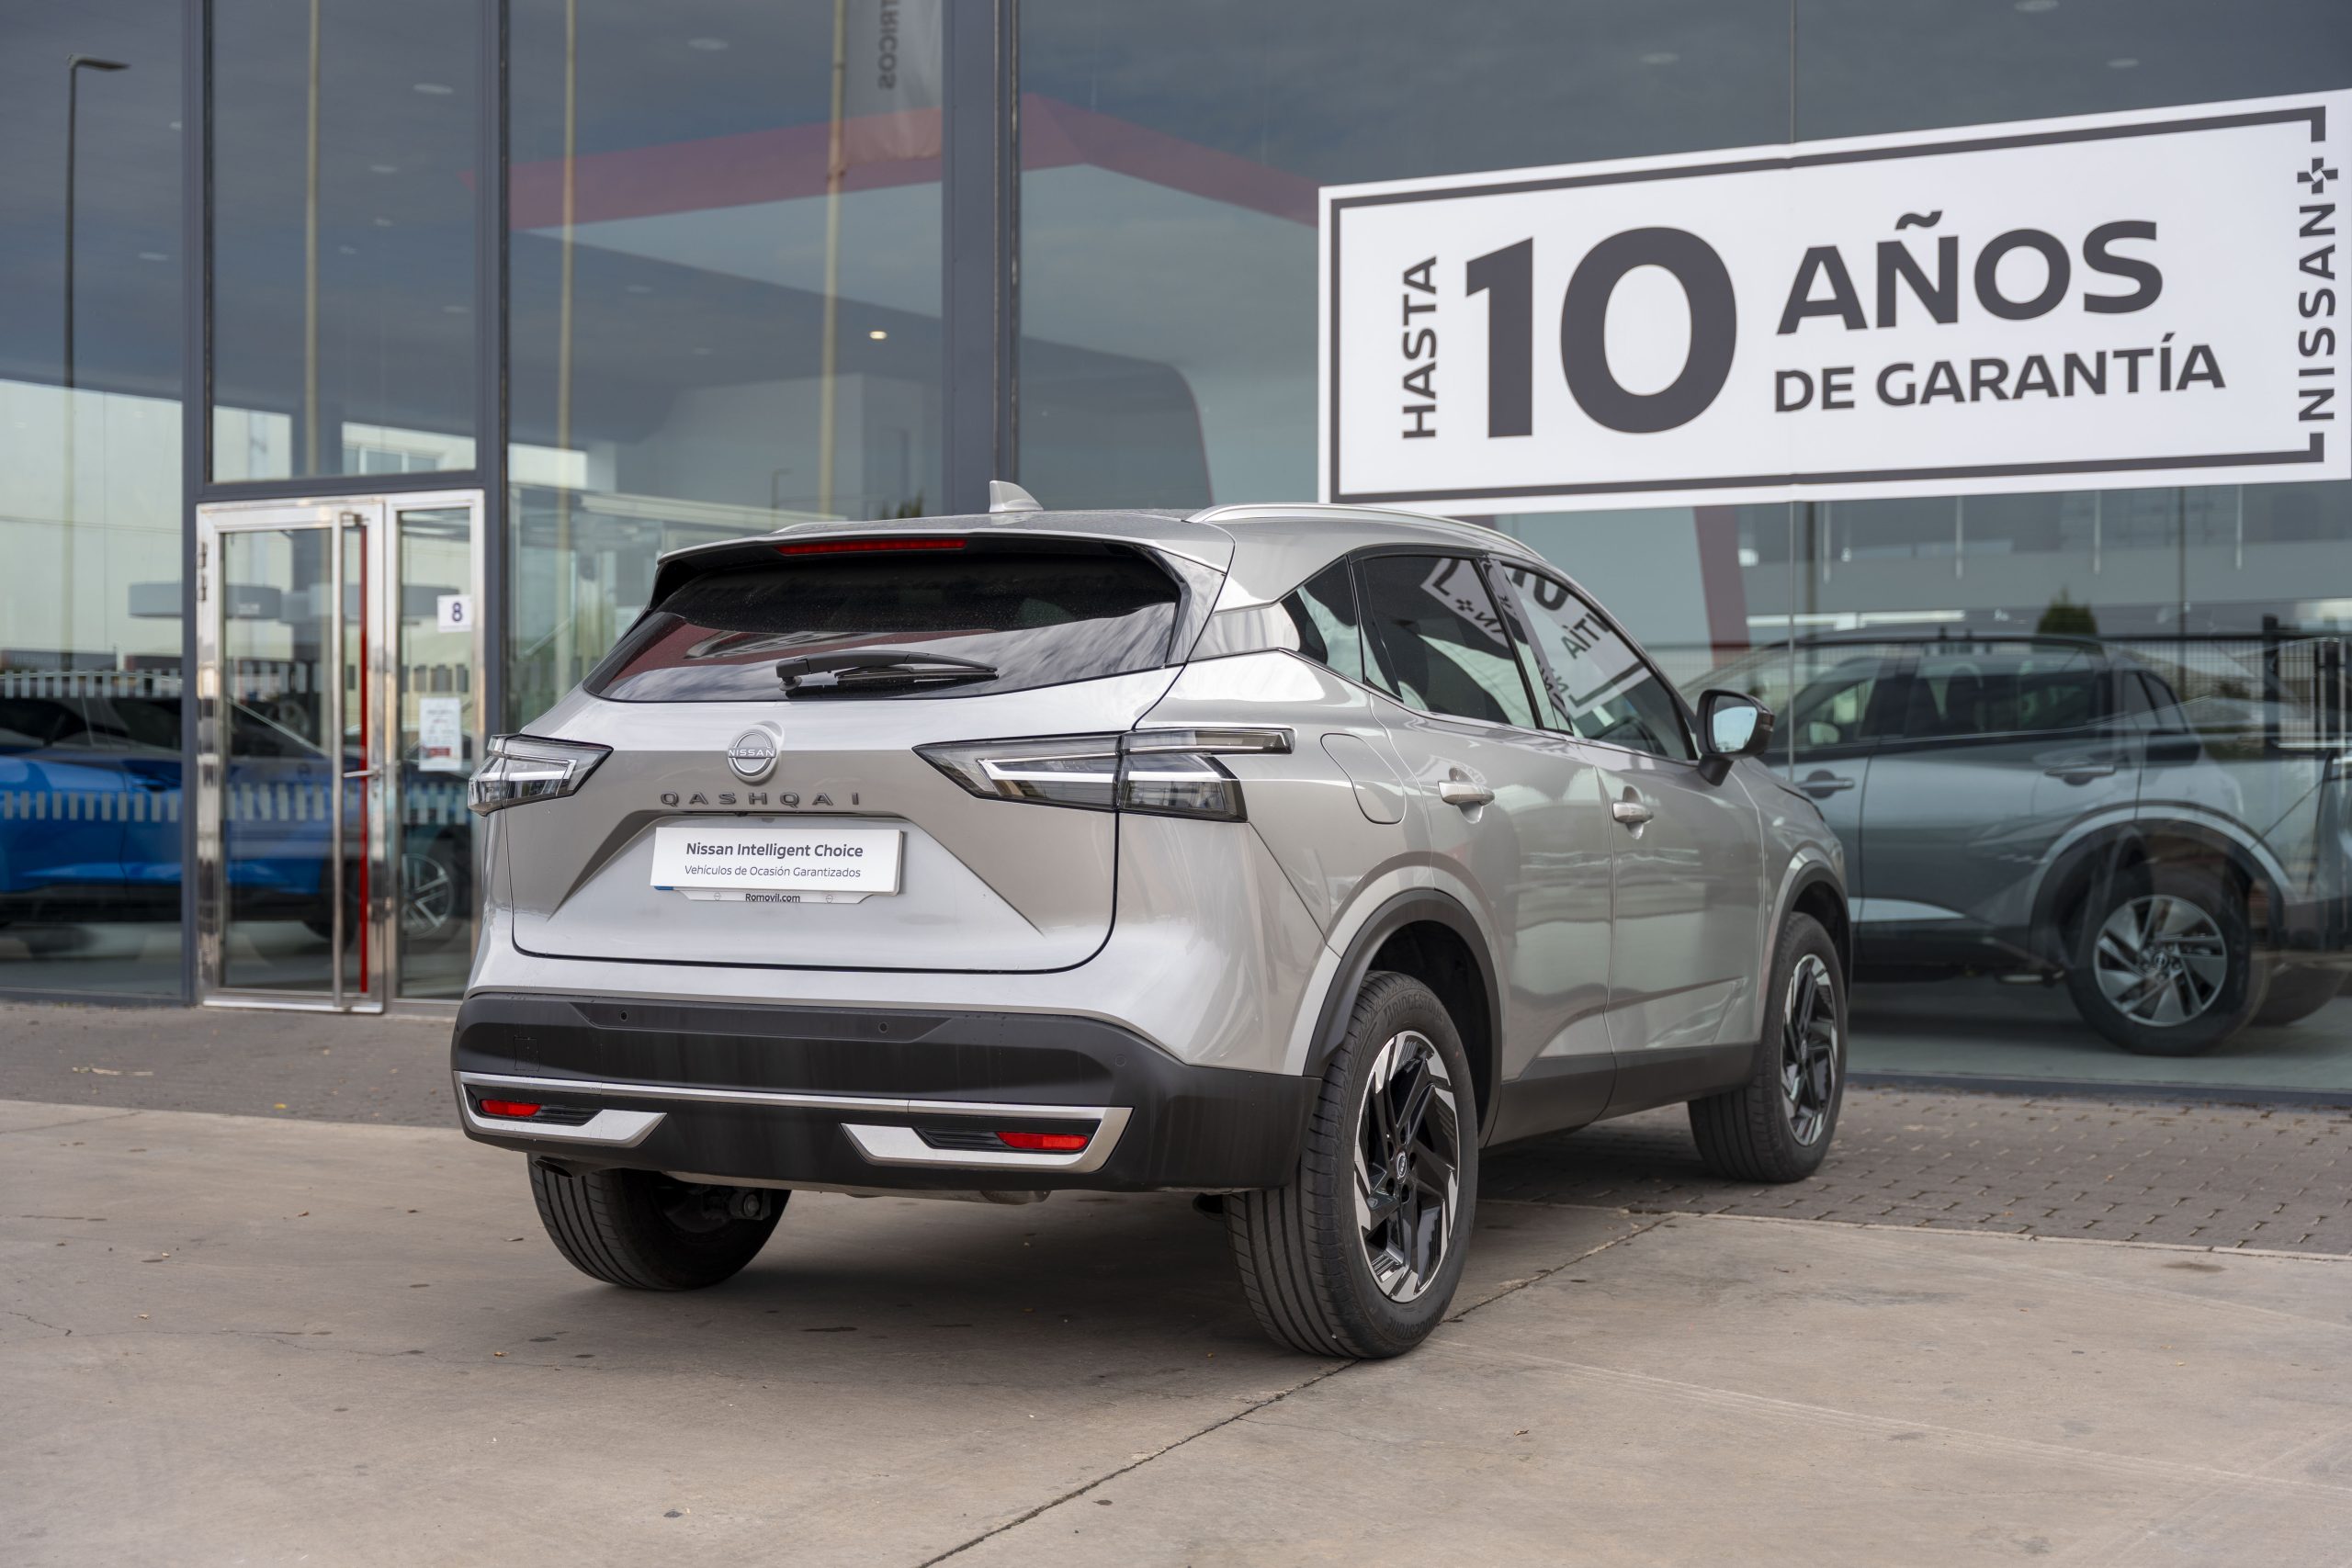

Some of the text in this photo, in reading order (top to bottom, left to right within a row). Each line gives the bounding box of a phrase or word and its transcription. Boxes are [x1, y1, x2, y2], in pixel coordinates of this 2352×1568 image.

[1466, 210, 2164, 439] 10 AÑOS
[1403, 256, 1437, 439] HASTA
[1775, 333, 2226, 412] DE GARANTÍA
[452, 602, 462, 622] 8
[729, 749, 775, 757] NISSAN
[660, 791, 861, 808] QASHQAI
[685, 841, 865, 860] Nissan Intelligent Choice
[684, 864, 862, 878] Vehículos de Ocasión Garantizados
[745, 892, 801, 904] Romovil.com
